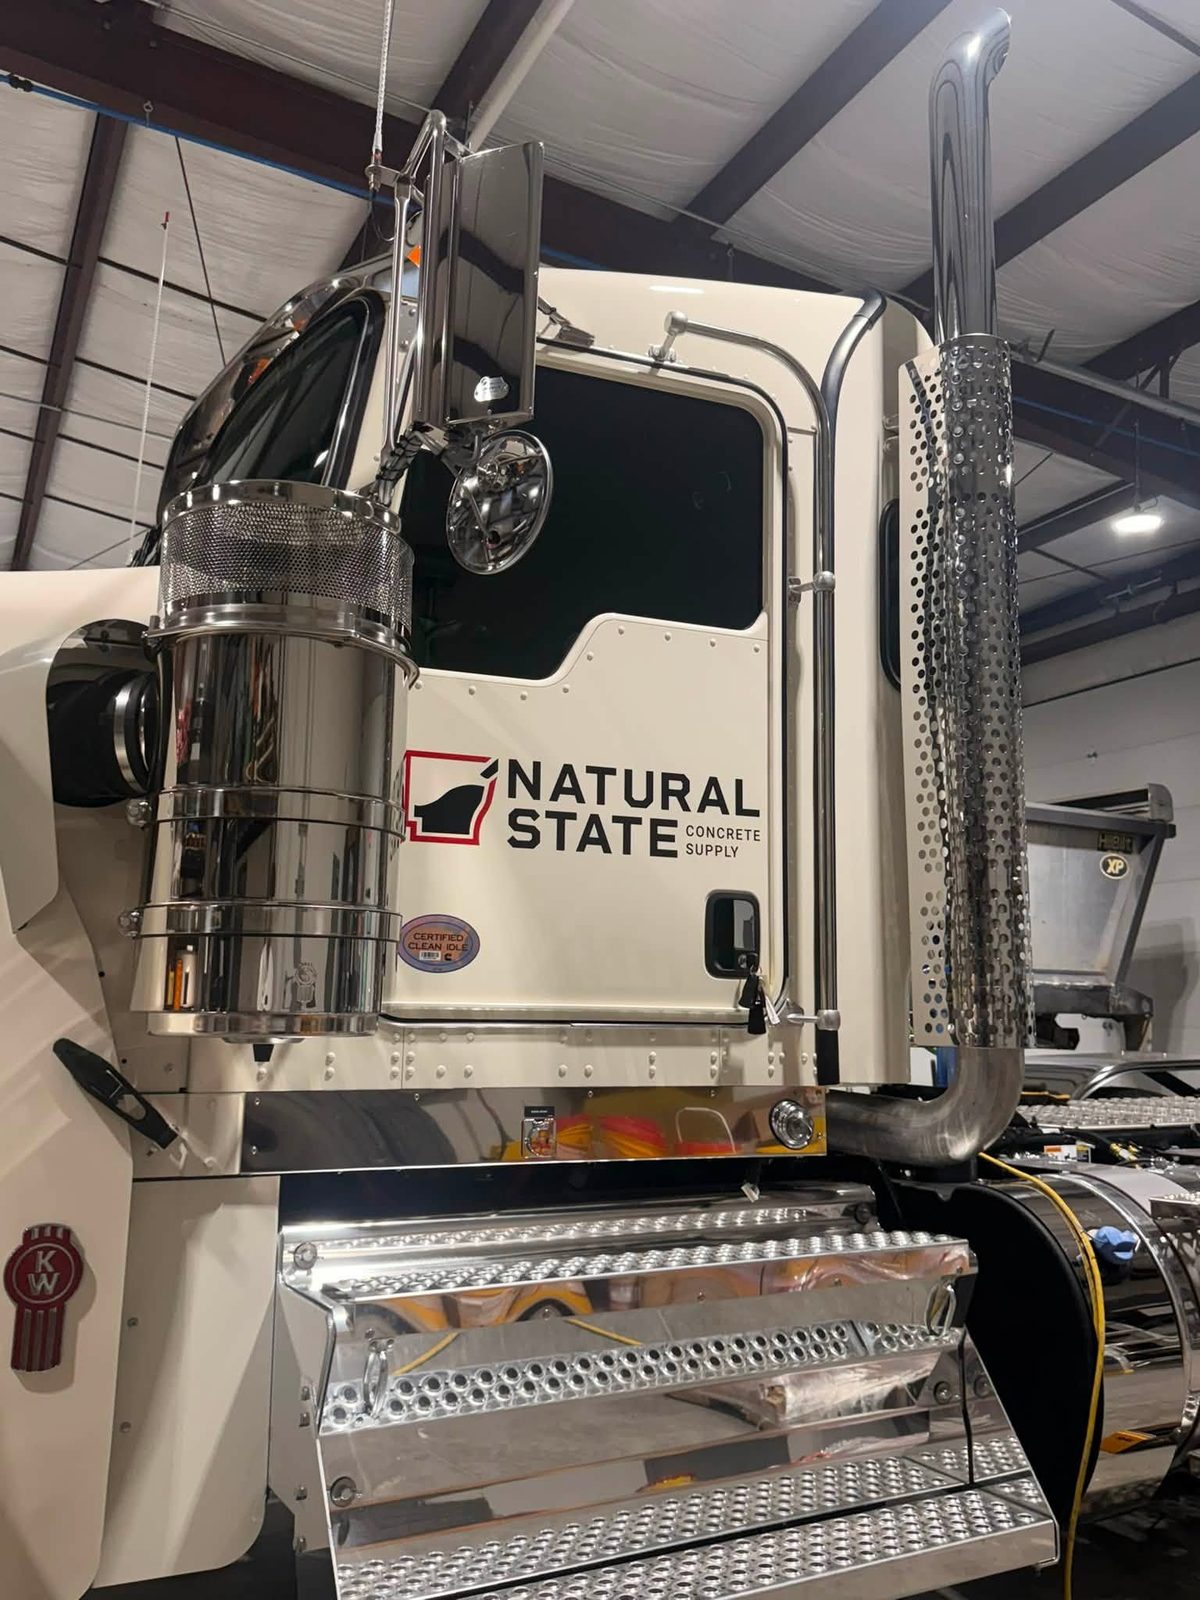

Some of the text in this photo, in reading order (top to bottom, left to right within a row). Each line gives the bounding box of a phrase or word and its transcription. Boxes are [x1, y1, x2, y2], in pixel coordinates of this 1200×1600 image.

[508, 758, 760, 817] NATURAL
[508, 808, 678, 858] STATE
[685, 825, 761, 842] CONCRETE
[685, 843, 738, 858] SUPPLY
[1107, 858, 1124, 874] XP
[413, 932, 464, 942] CERTIFIED
[407, 942, 469, 952] CLEAN IDLE
[36, 1250, 57, 1272] K
[28, 1272, 60, 1295] W
